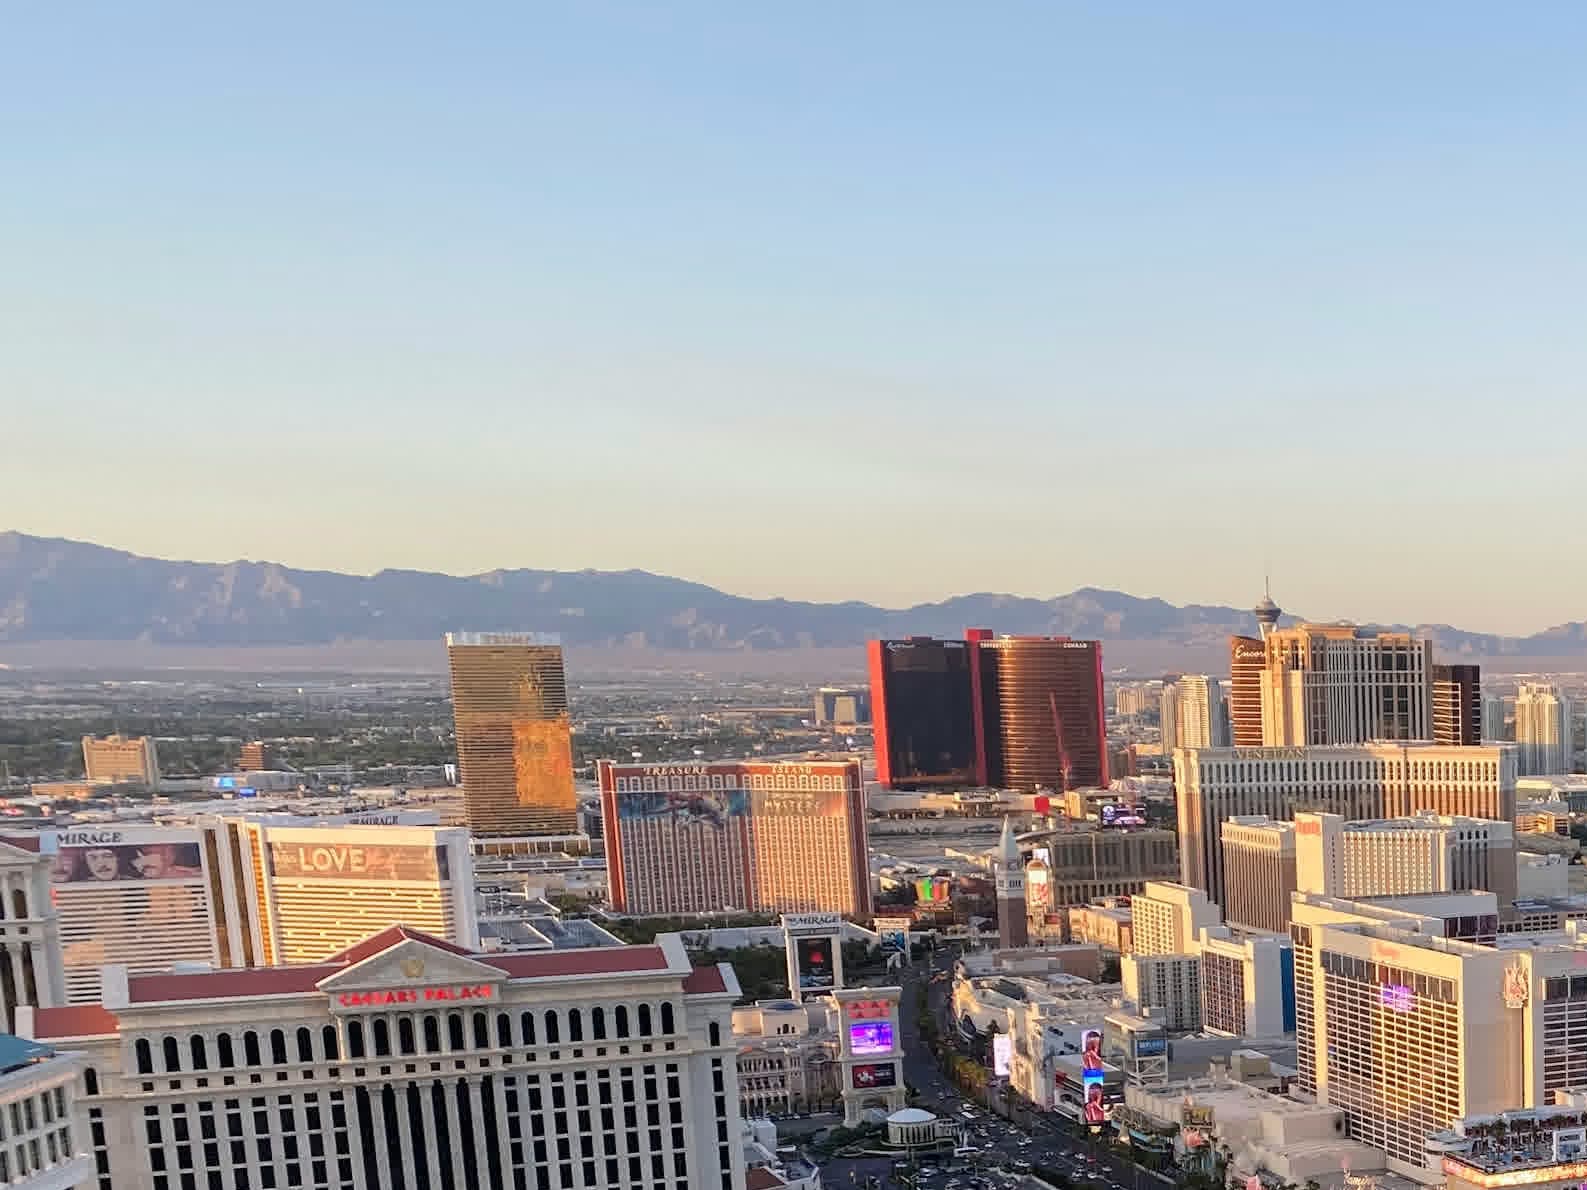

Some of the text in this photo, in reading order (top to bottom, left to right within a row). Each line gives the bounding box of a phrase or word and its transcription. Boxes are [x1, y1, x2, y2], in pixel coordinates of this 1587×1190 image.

[1235, 645, 1267, 659] Encor
[642, 766, 706, 776] TREASURE
[56, 832, 122, 845] MIRAGE
[298, 847, 368, 873] LOVE
[799, 915, 840, 926] MIRAGE
